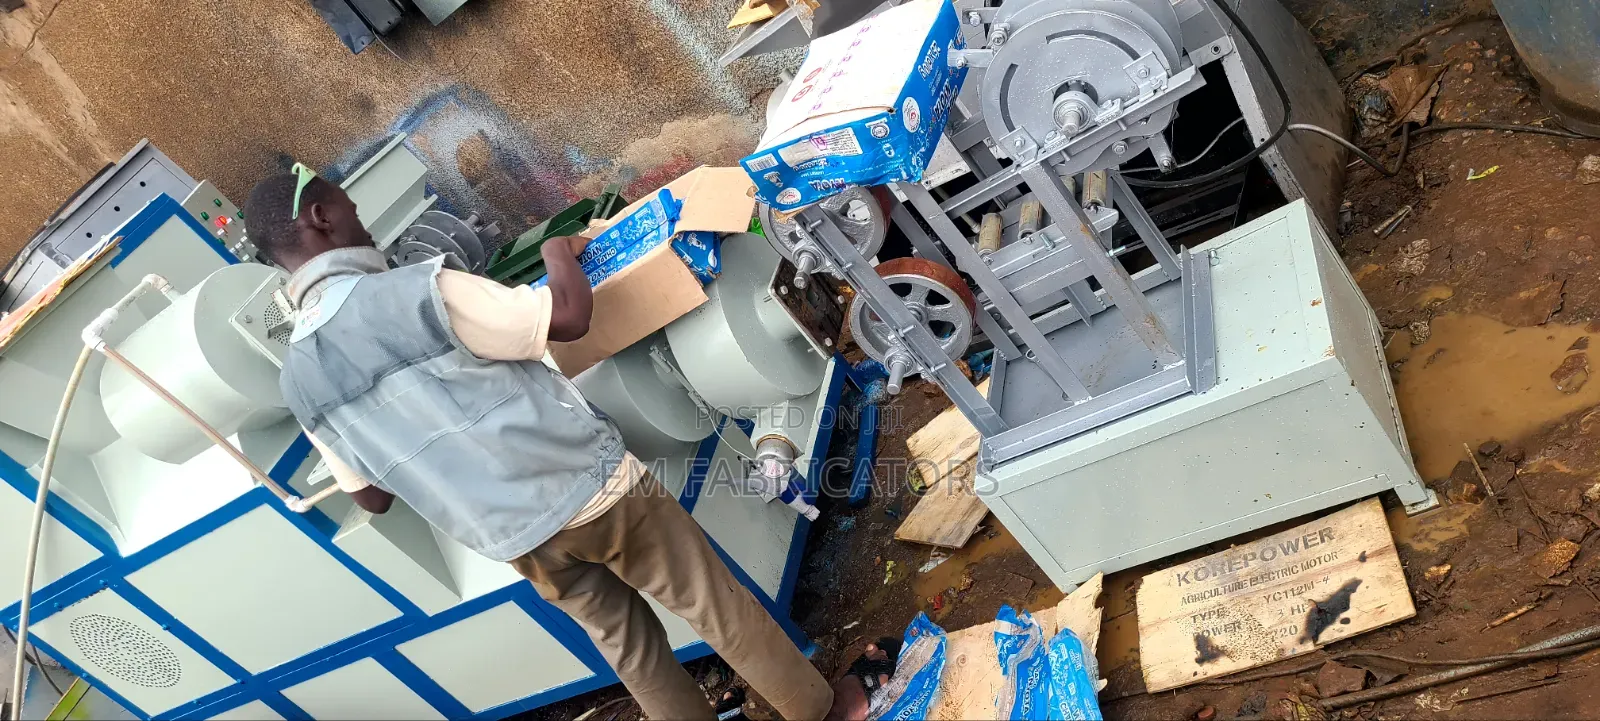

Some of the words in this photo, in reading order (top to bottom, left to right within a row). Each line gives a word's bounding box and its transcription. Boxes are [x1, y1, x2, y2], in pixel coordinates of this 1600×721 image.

[595, 247, 616, 265] CHAPA
[1176, 526, 1336, 587] KOREPOWER
[1181, 579, 1249, 606] AGRICULTURE
[1249, 564, 1300, 587] ELECTRIC
[1301, 551, 1339, 572] MOTOR
